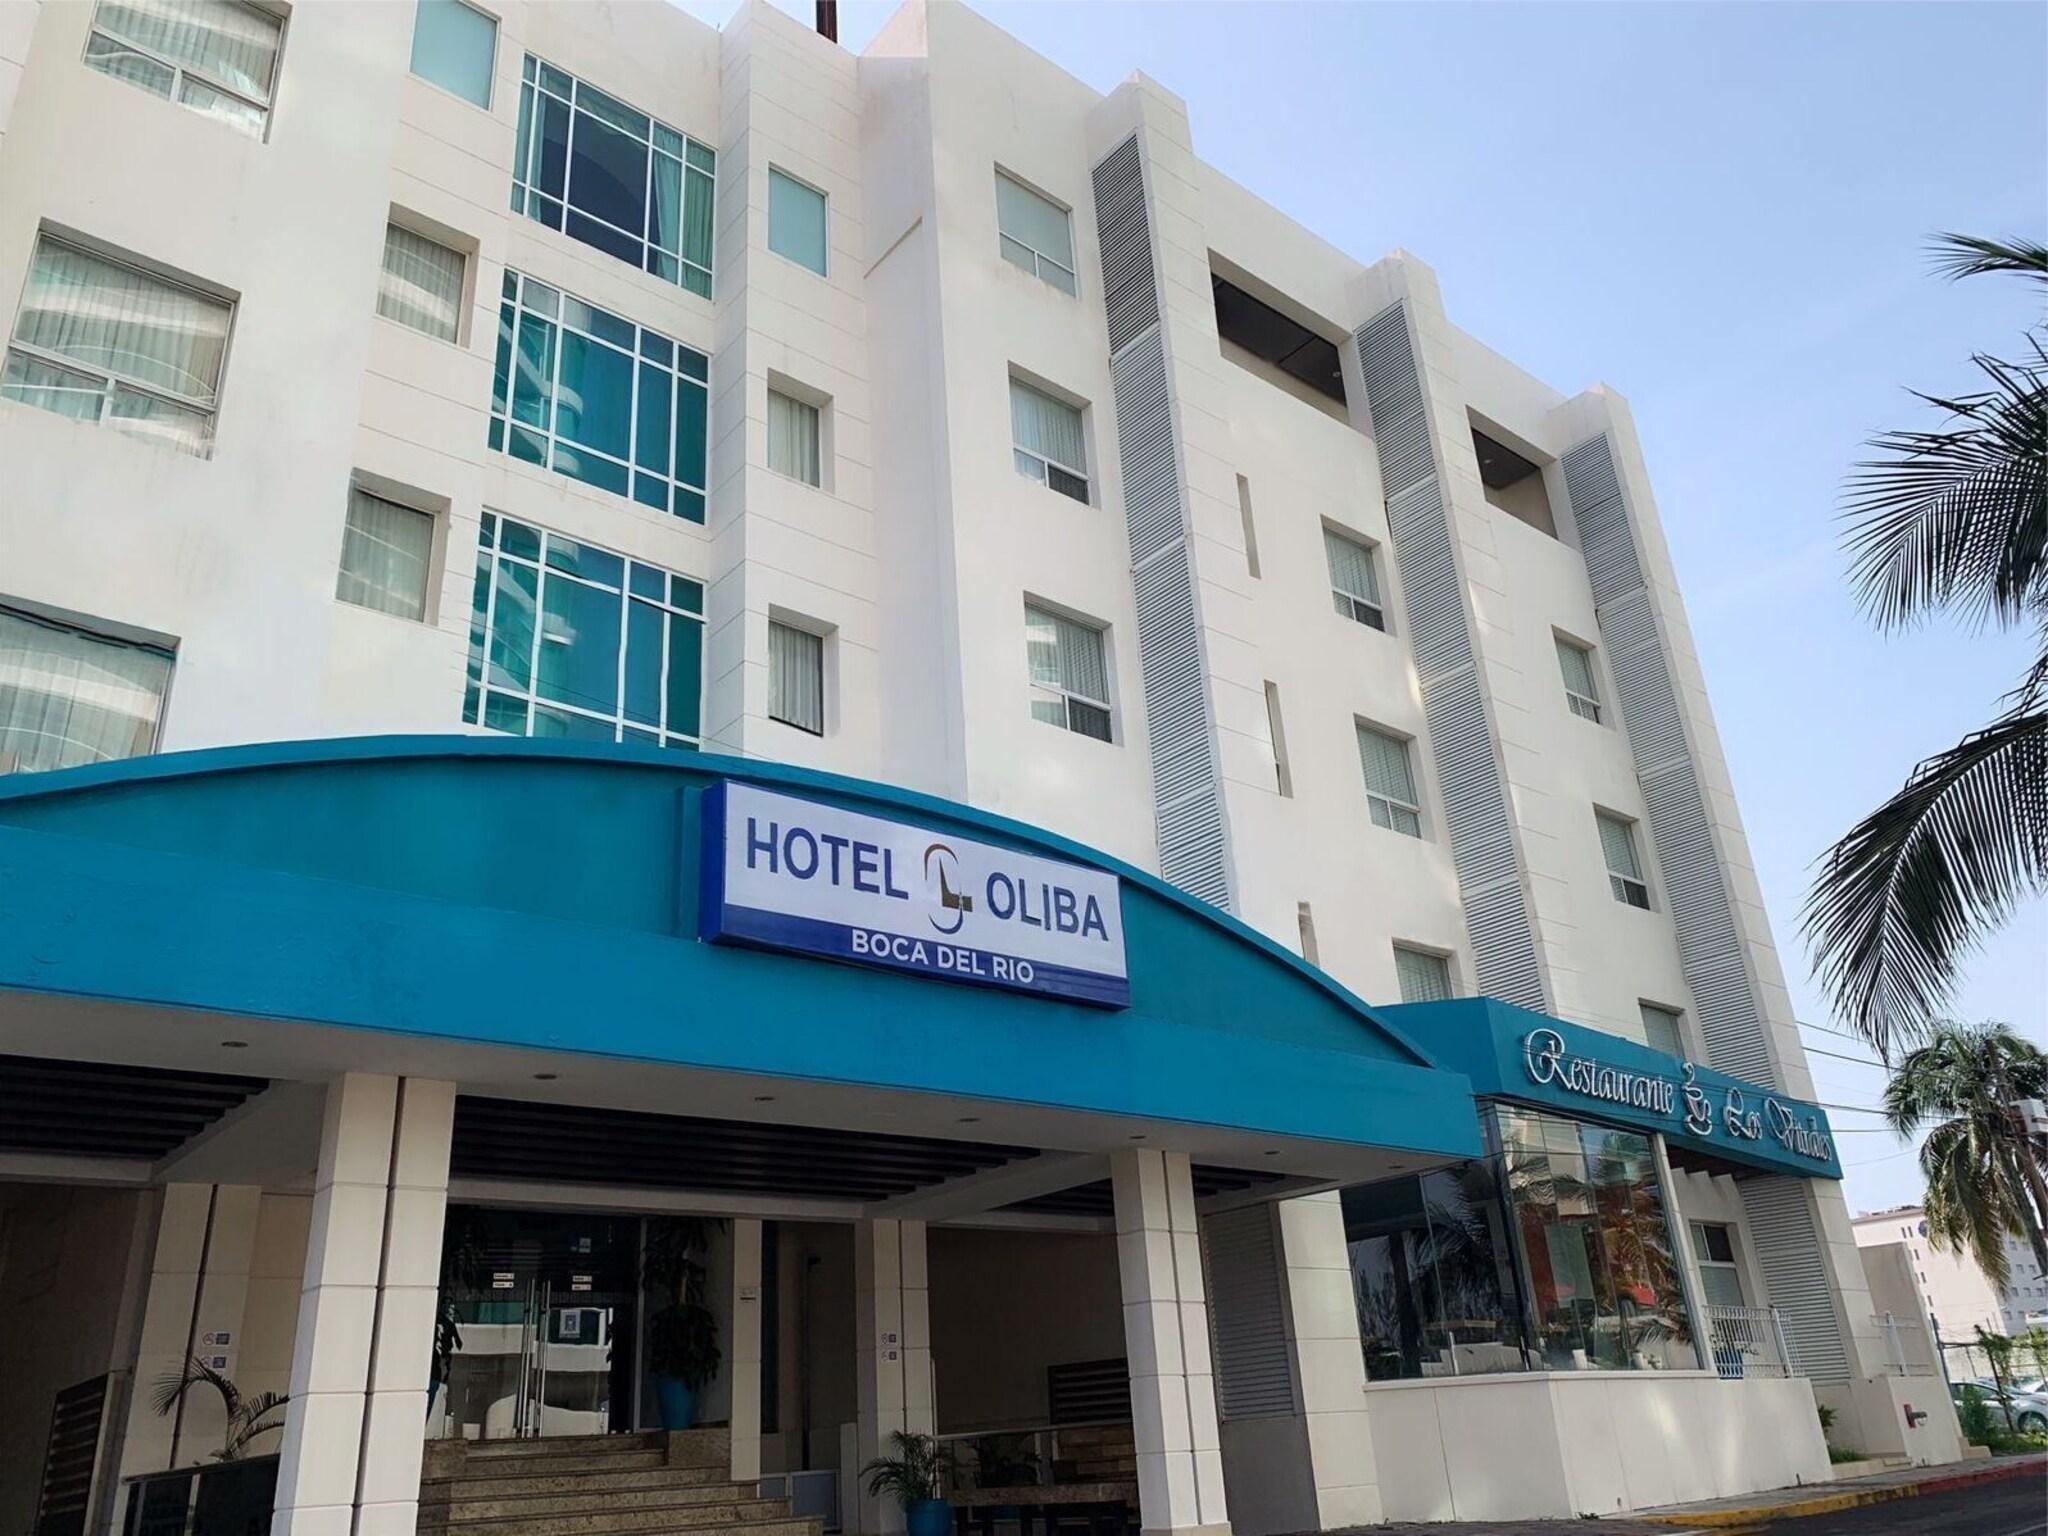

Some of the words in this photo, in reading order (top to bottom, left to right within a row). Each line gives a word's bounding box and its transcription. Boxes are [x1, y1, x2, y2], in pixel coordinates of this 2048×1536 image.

[747, 817, 909, 900] HOTEL
[986, 871, 1109, 941] OLIBA
[852, 929, 928, 965] BOCA
[937, 946, 986, 975] DEL
[992, 956, 1034, 983] RIO
[1524, 1028, 1675, 1114] Restaurante
[1723, 1086, 1762, 1140] Los
